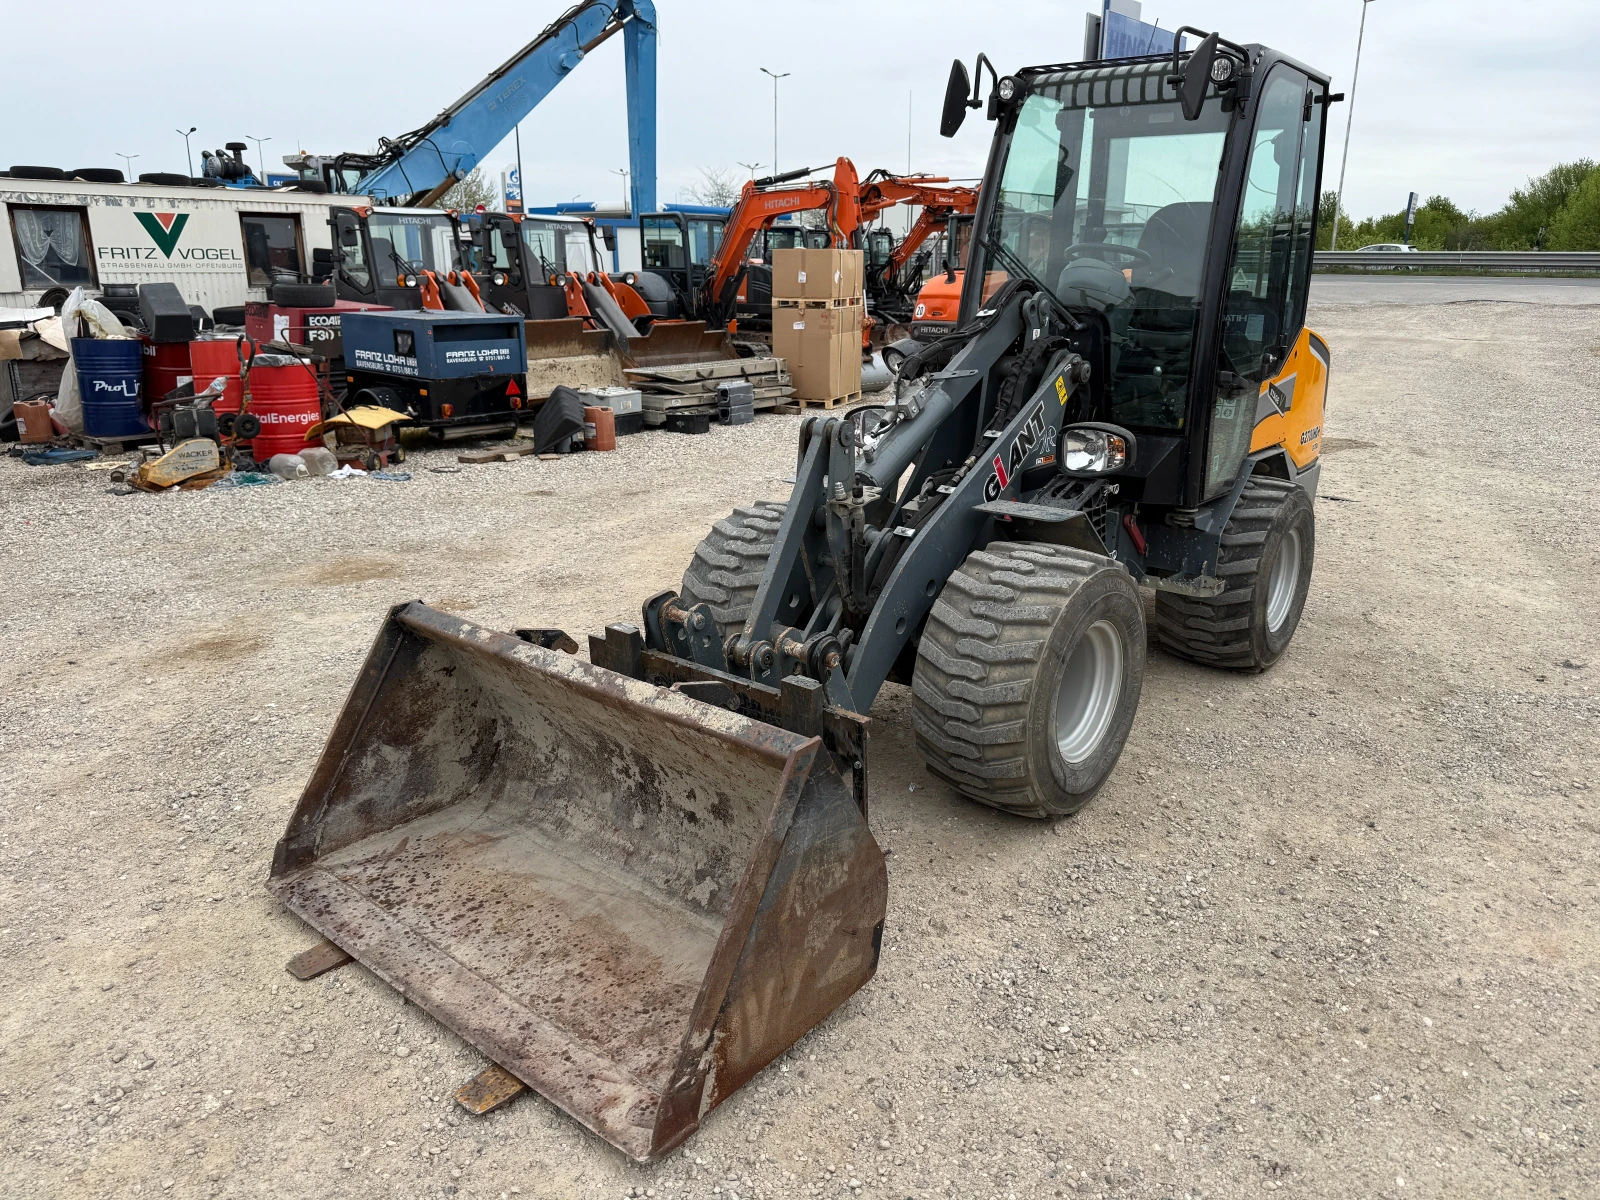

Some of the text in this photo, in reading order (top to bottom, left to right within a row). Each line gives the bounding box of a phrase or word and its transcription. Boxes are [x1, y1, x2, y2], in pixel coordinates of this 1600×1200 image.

[496, 75, 527, 102] TEREX
[764, 196, 800, 210] HITACHI
[398, 217, 431, 225] HITACHI
[545, 223, 573, 231] HITACHI
[98, 247, 242, 260] FRITZ VOGEL
[916, 306, 924, 316] 20
[308, 329, 335, 342] F30
[920, 326, 949, 334] HITACHI
[355, 349, 383, 362] FRANZ
[383, 353, 406, 365] LOHR
[446, 350, 476, 358] FRANZ
[356, 360, 384, 371] RAVENSBURG
[248, 411, 320, 425] talEnergies
[178, 449, 213, 458] WACKER
[983, 400, 1046, 503] GIANT
